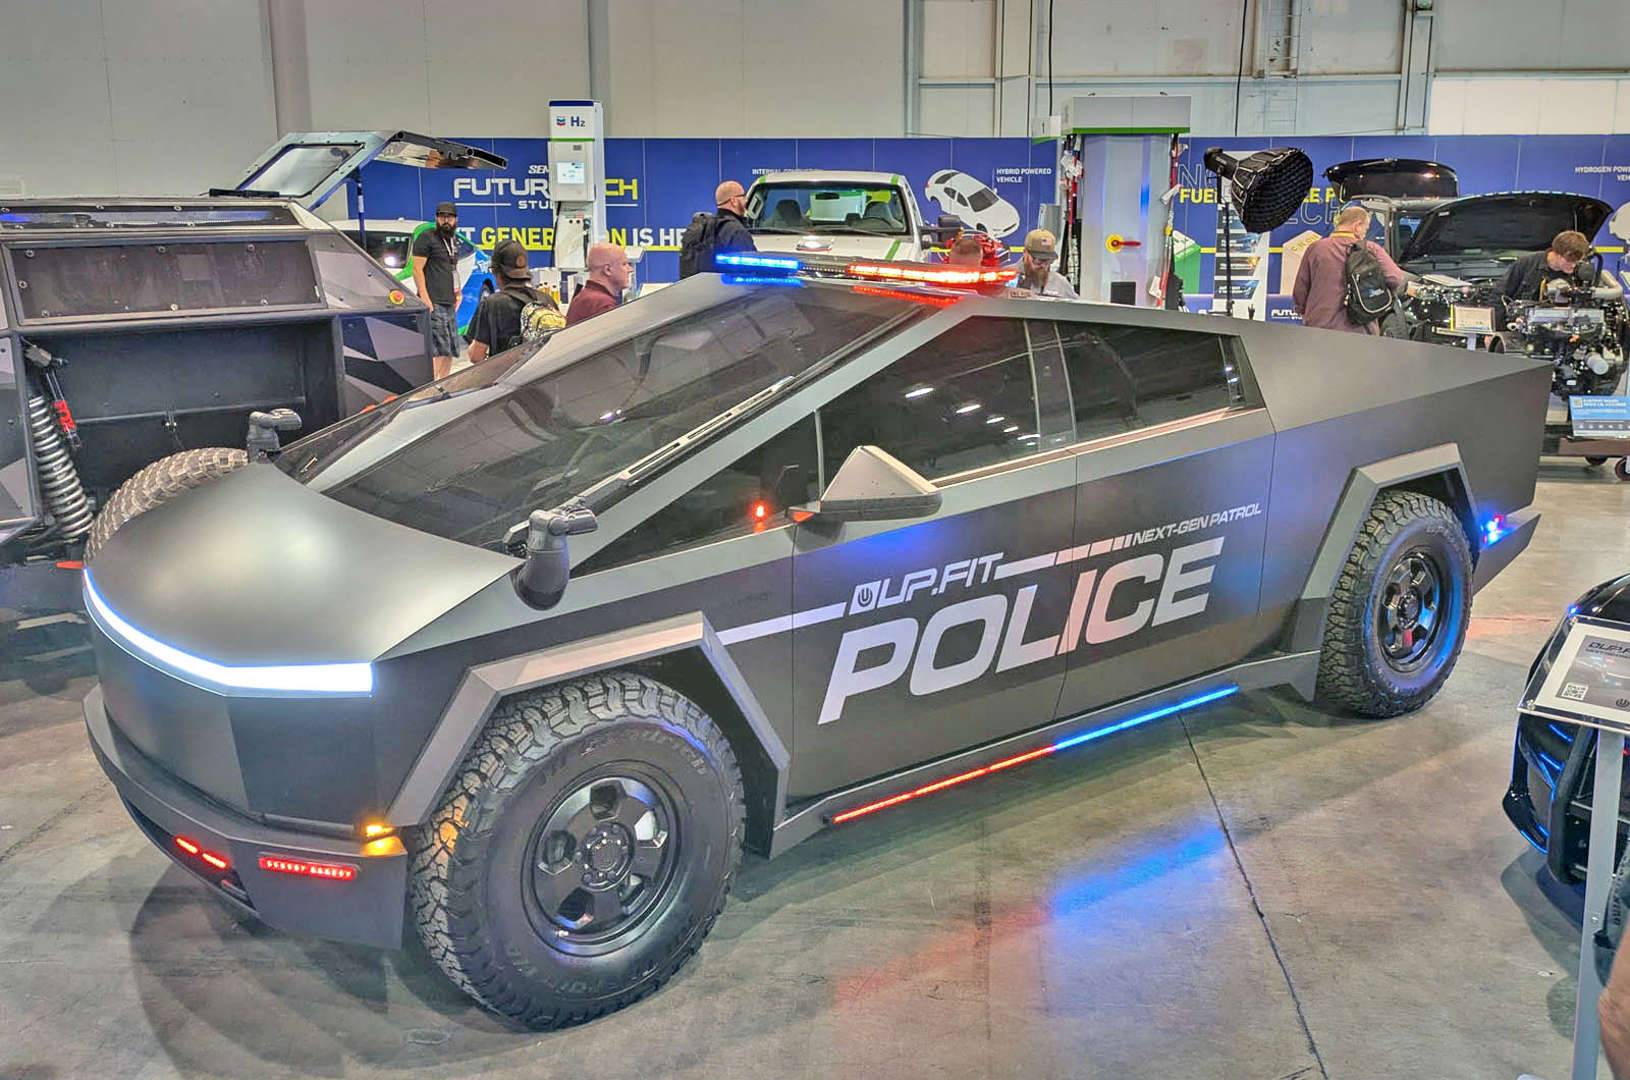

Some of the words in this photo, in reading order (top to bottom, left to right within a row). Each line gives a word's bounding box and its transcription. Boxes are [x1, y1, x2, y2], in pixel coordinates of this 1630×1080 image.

[571, 116, 586, 128] H2
[1020, 167, 1052, 175] POWERED
[632, 228, 654, 246] IS
[1132, 515, 1209, 546] NEXT-GEN
[1208, 502, 1262, 527] PATROL
[818, 537, 1224, 725] POLICE
